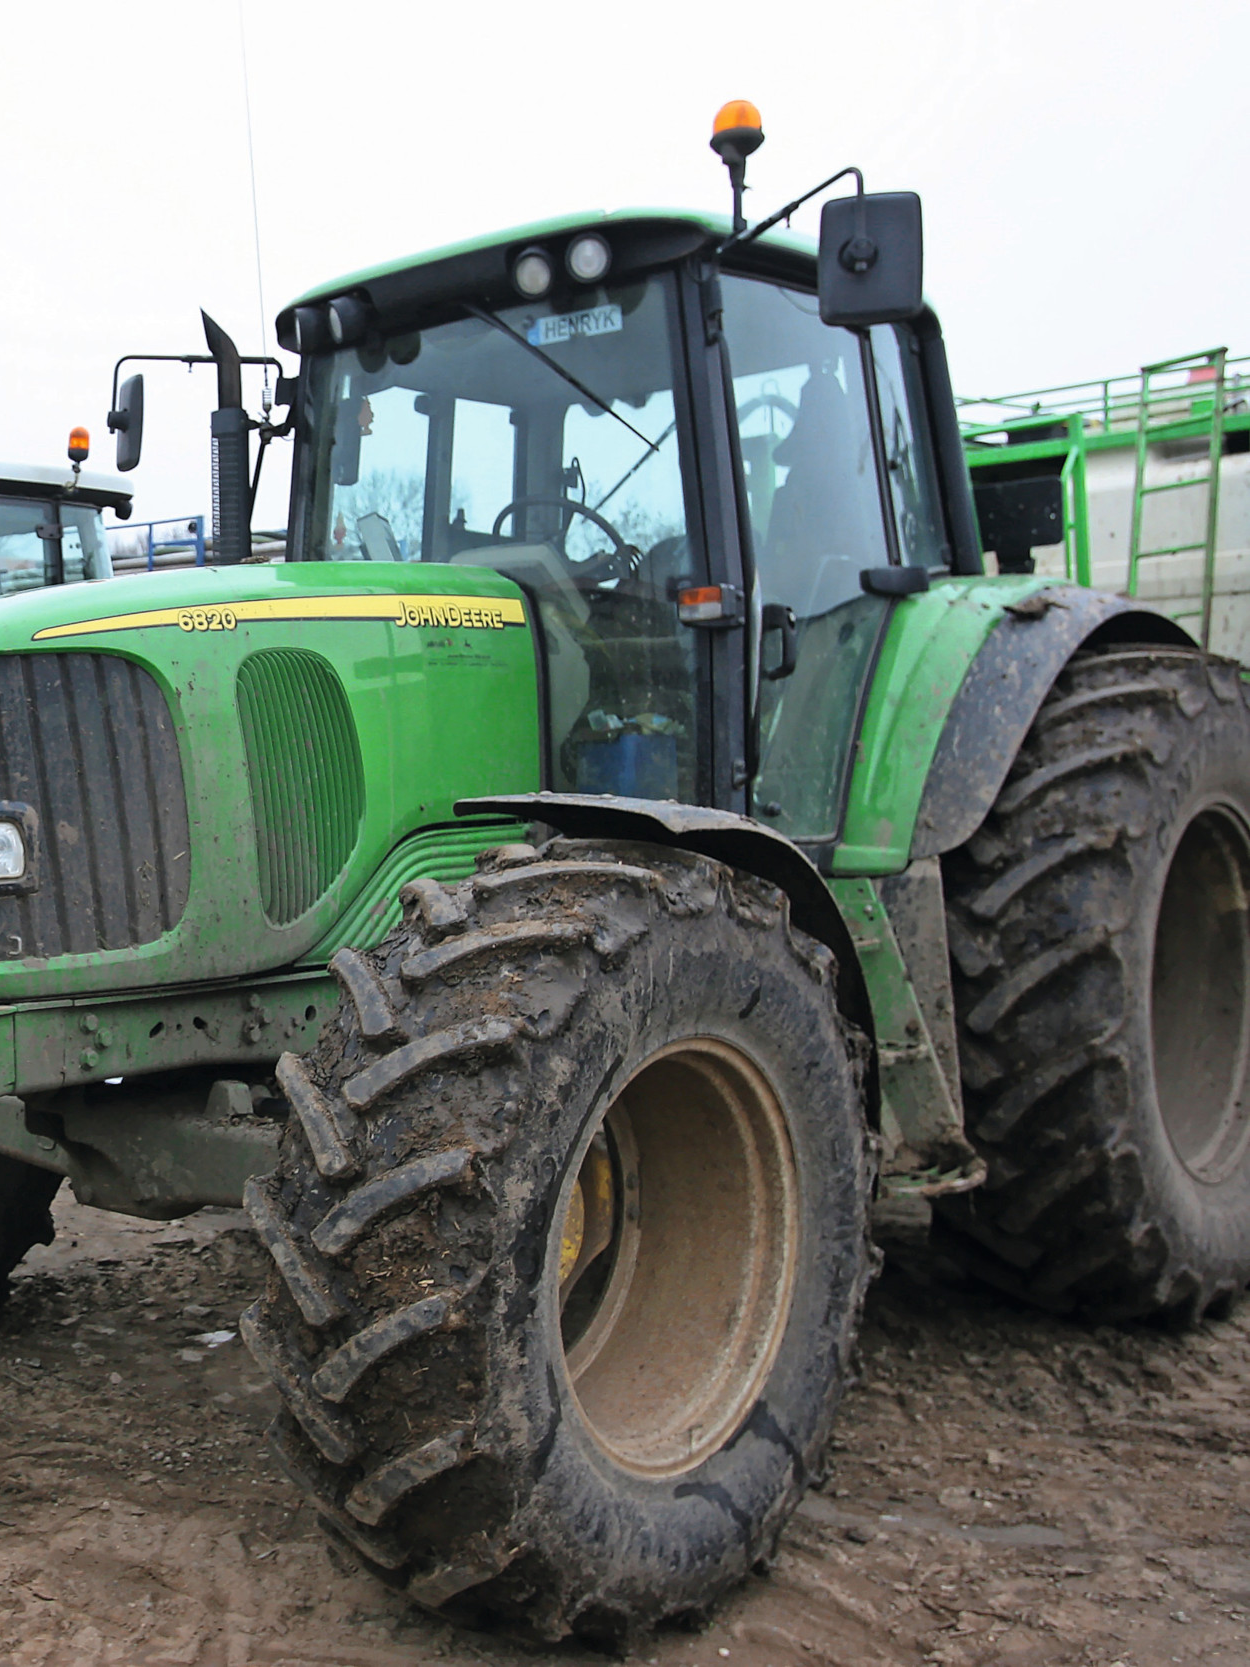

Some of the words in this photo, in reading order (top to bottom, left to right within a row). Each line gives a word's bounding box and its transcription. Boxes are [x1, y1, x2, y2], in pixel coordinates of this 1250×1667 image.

[544, 309, 615, 338] HENRYK
[178, 608, 237, 632] 6820
[395, 601, 447, 627] JOHN
[445, 603, 504, 629] DEERE
